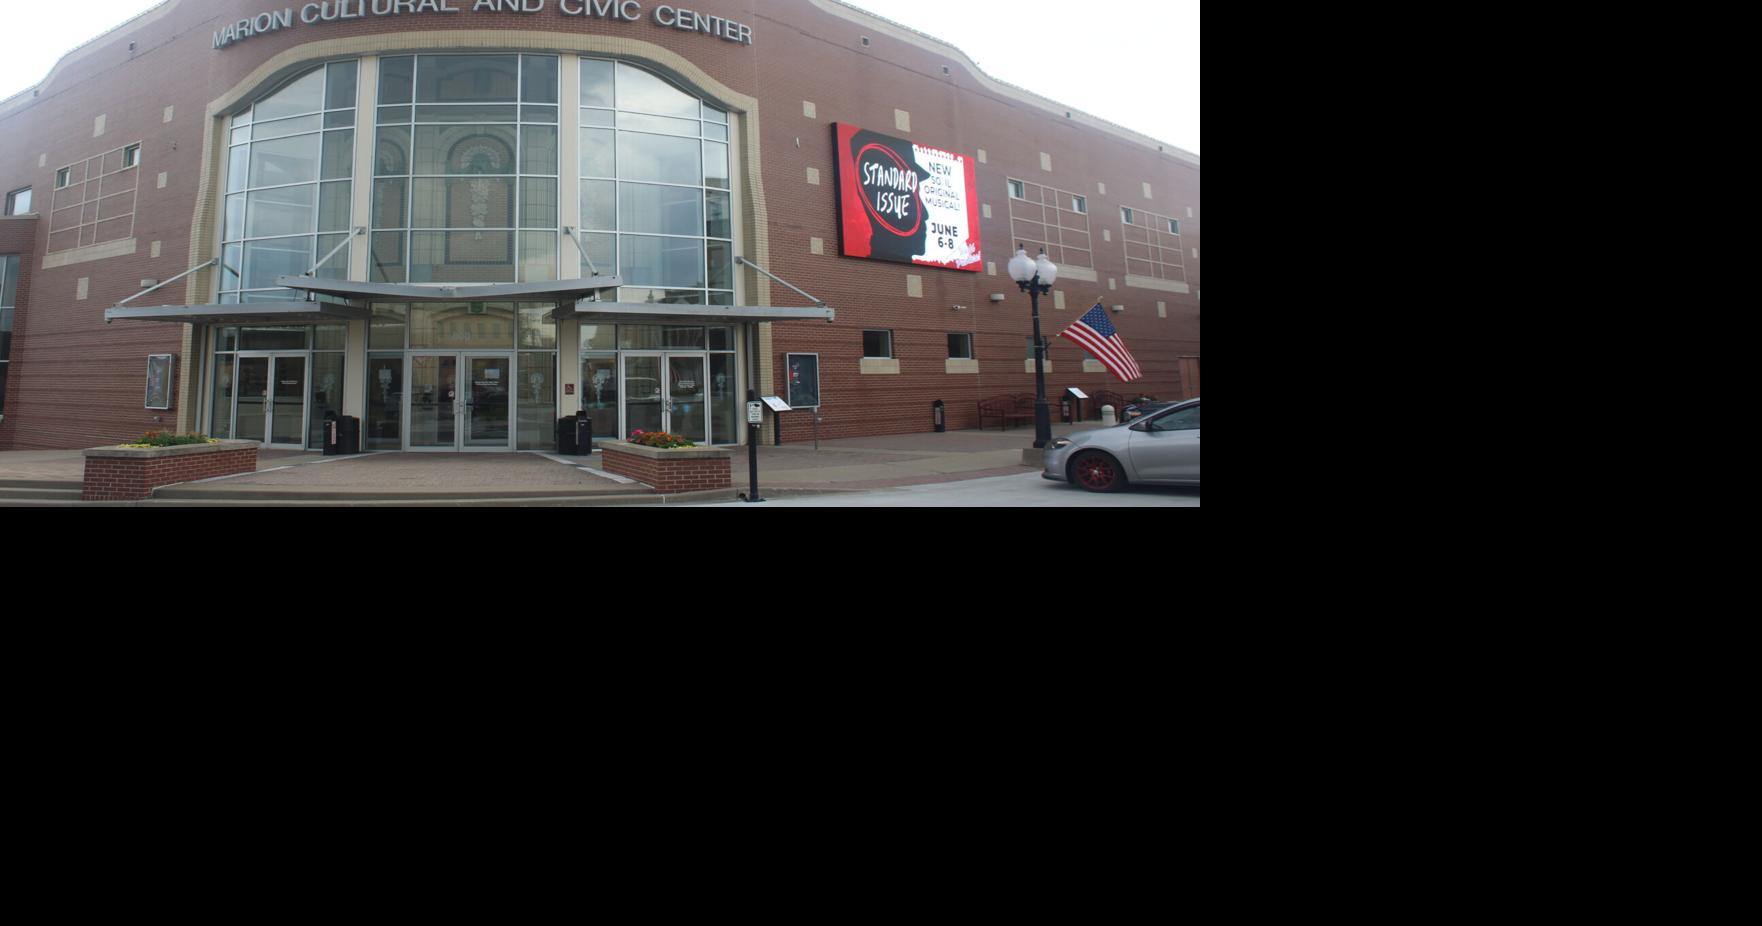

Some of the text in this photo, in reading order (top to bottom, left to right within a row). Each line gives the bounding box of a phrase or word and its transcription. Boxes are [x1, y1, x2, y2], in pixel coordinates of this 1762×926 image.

[212, 0, 753, 49] MARION CULTURAL AND CIVIC CENTER
[863, 161, 918, 193] STANDARD
[928, 161, 952, 177] NEW
[924, 185, 960, 200] ORIGINAL
[877, 191, 911, 219] ISSUE
[931, 222, 959, 238] JUNE
